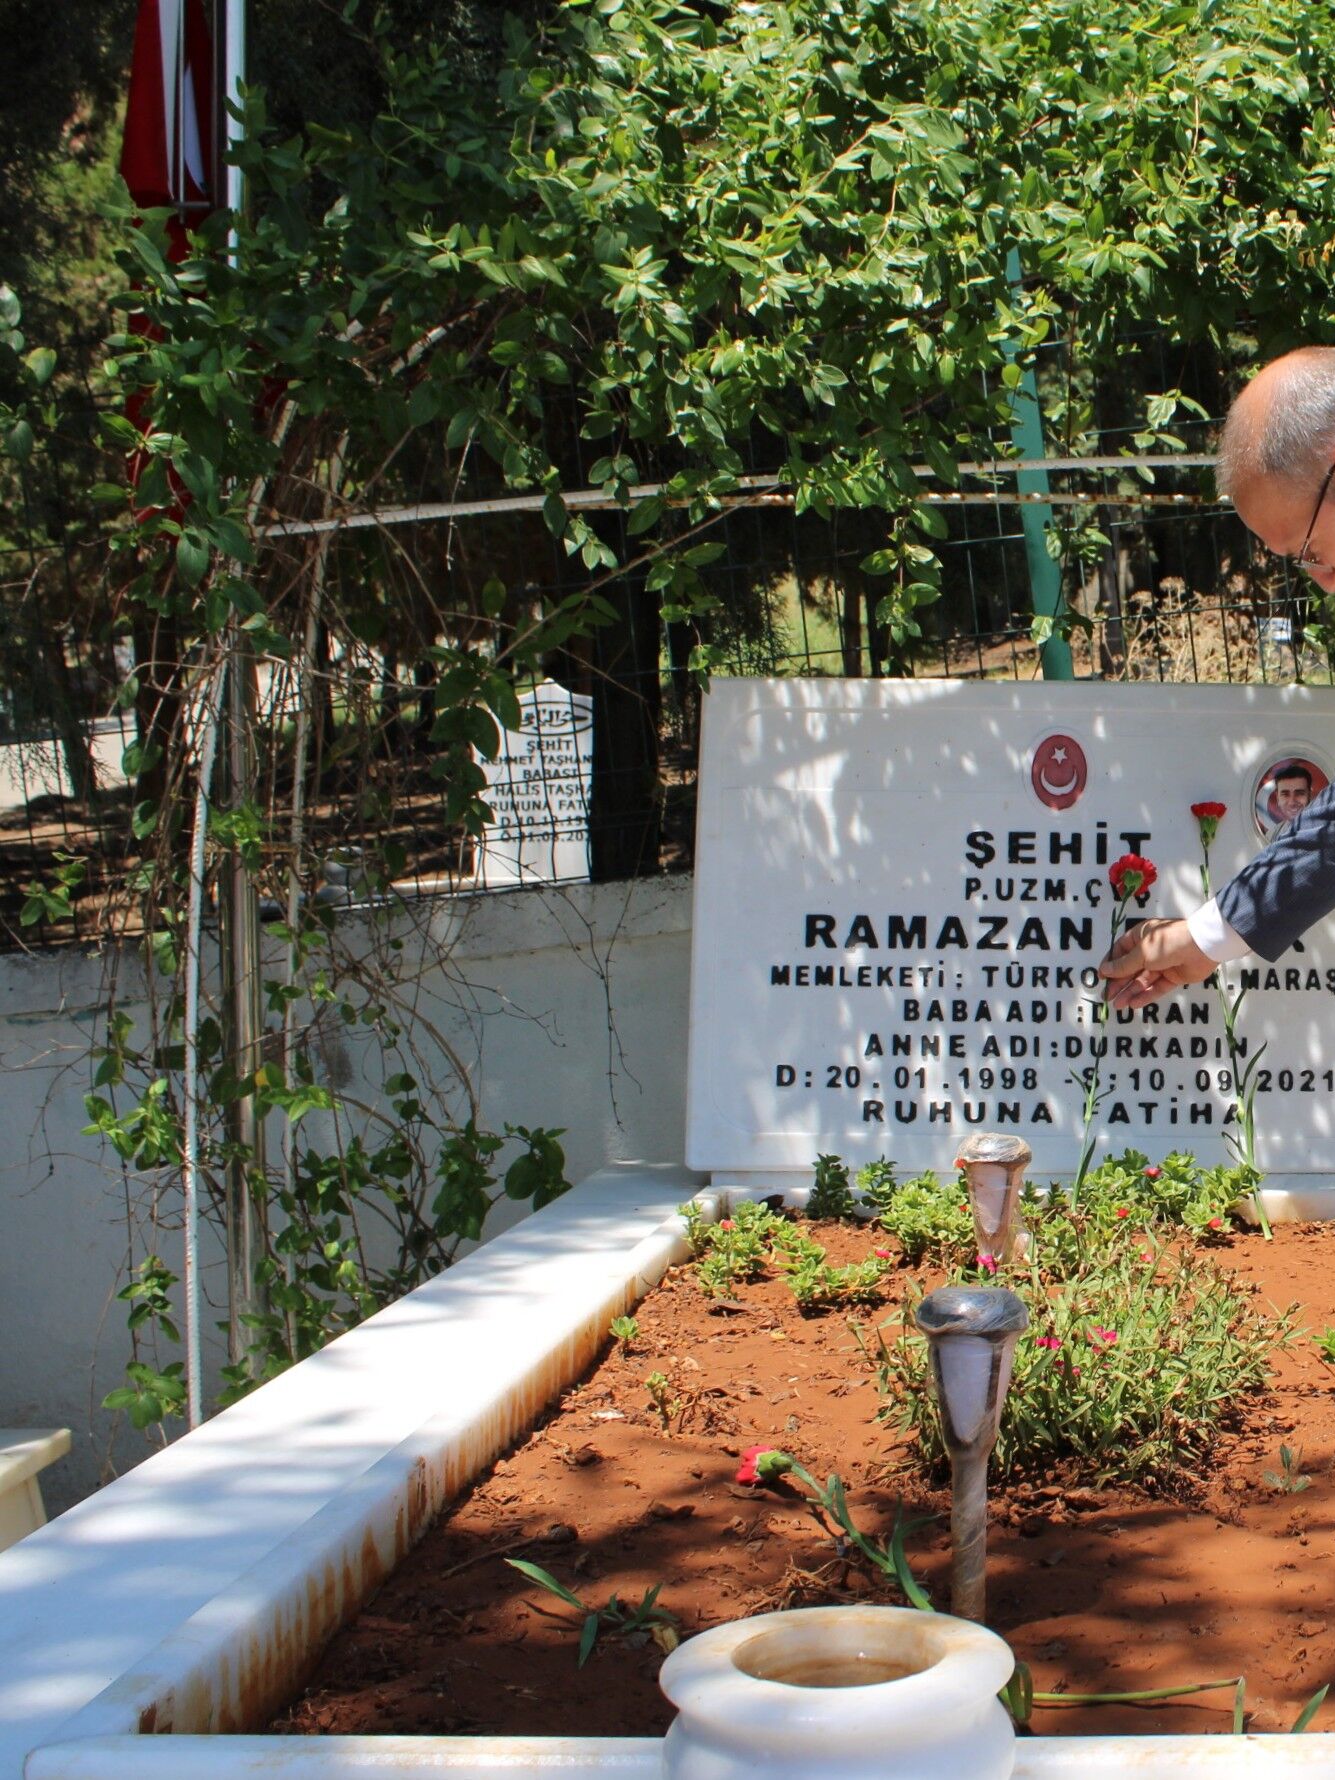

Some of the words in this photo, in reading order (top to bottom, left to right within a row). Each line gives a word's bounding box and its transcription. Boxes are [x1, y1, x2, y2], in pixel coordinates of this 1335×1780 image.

[965, 822, 1151, 869] ŞEHİT
[805, 914, 1092, 950] RAMAZAN
[903, 999, 993, 1022] BABA
[864, 1033, 966, 1058] ANNE
[862, 1100, 1053, 1124] RUHUNA
